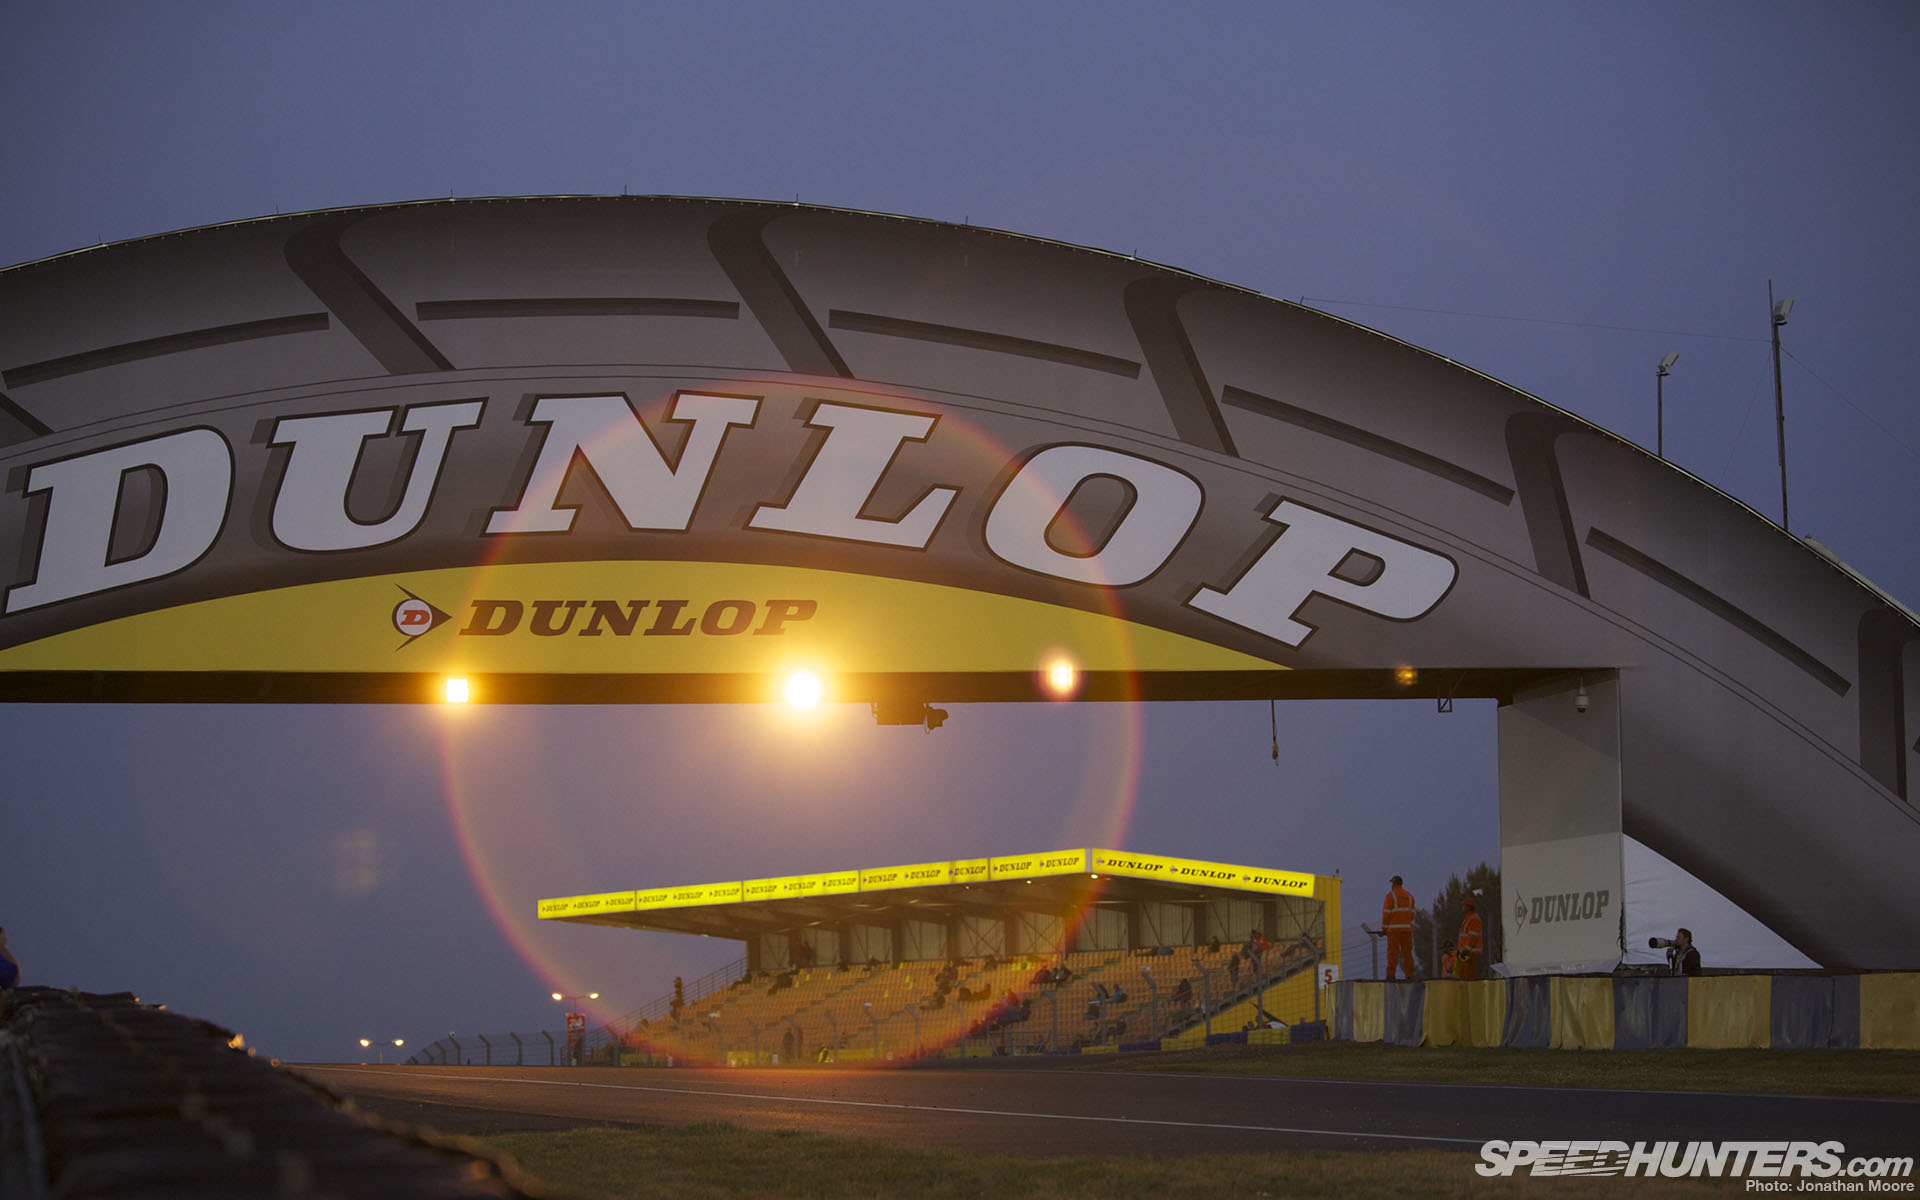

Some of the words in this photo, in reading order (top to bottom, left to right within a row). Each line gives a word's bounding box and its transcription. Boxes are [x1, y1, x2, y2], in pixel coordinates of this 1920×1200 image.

[5, 390, 1459, 648] DUNLOP
[458, 599, 818, 636] DUNLOP
[1106, 858, 1164, 872] DUNLOP
[1180, 867, 1236, 880] DUNLOP
[1253, 875, 1308, 889] DUNLOP
[1529, 890, 1609, 924] DUNLOP
[1324, 968, 1332, 984] 5
